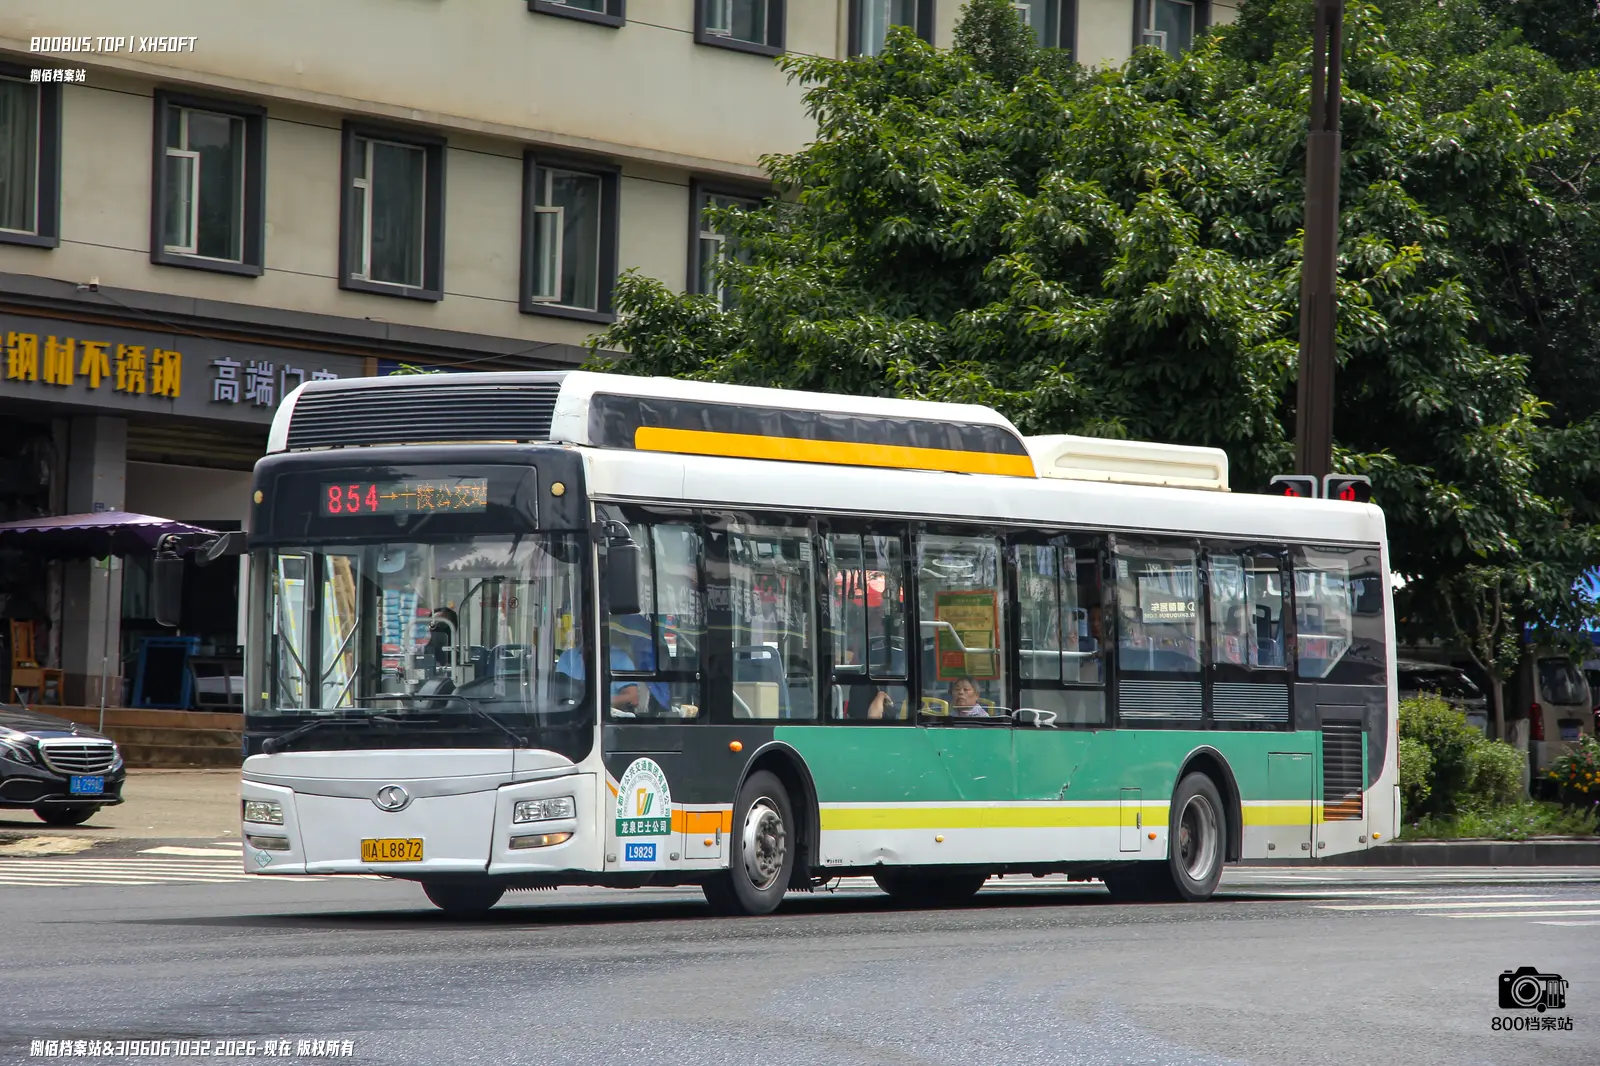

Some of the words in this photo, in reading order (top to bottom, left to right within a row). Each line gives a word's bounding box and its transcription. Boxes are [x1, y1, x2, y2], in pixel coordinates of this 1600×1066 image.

[0, 331, 182, 398] 钢材不锈钢
[328, 484, 378, 513] 854
[621, 820, 667, 834] 龙泉巴士公司
[629, 846, 653, 858] L9829
